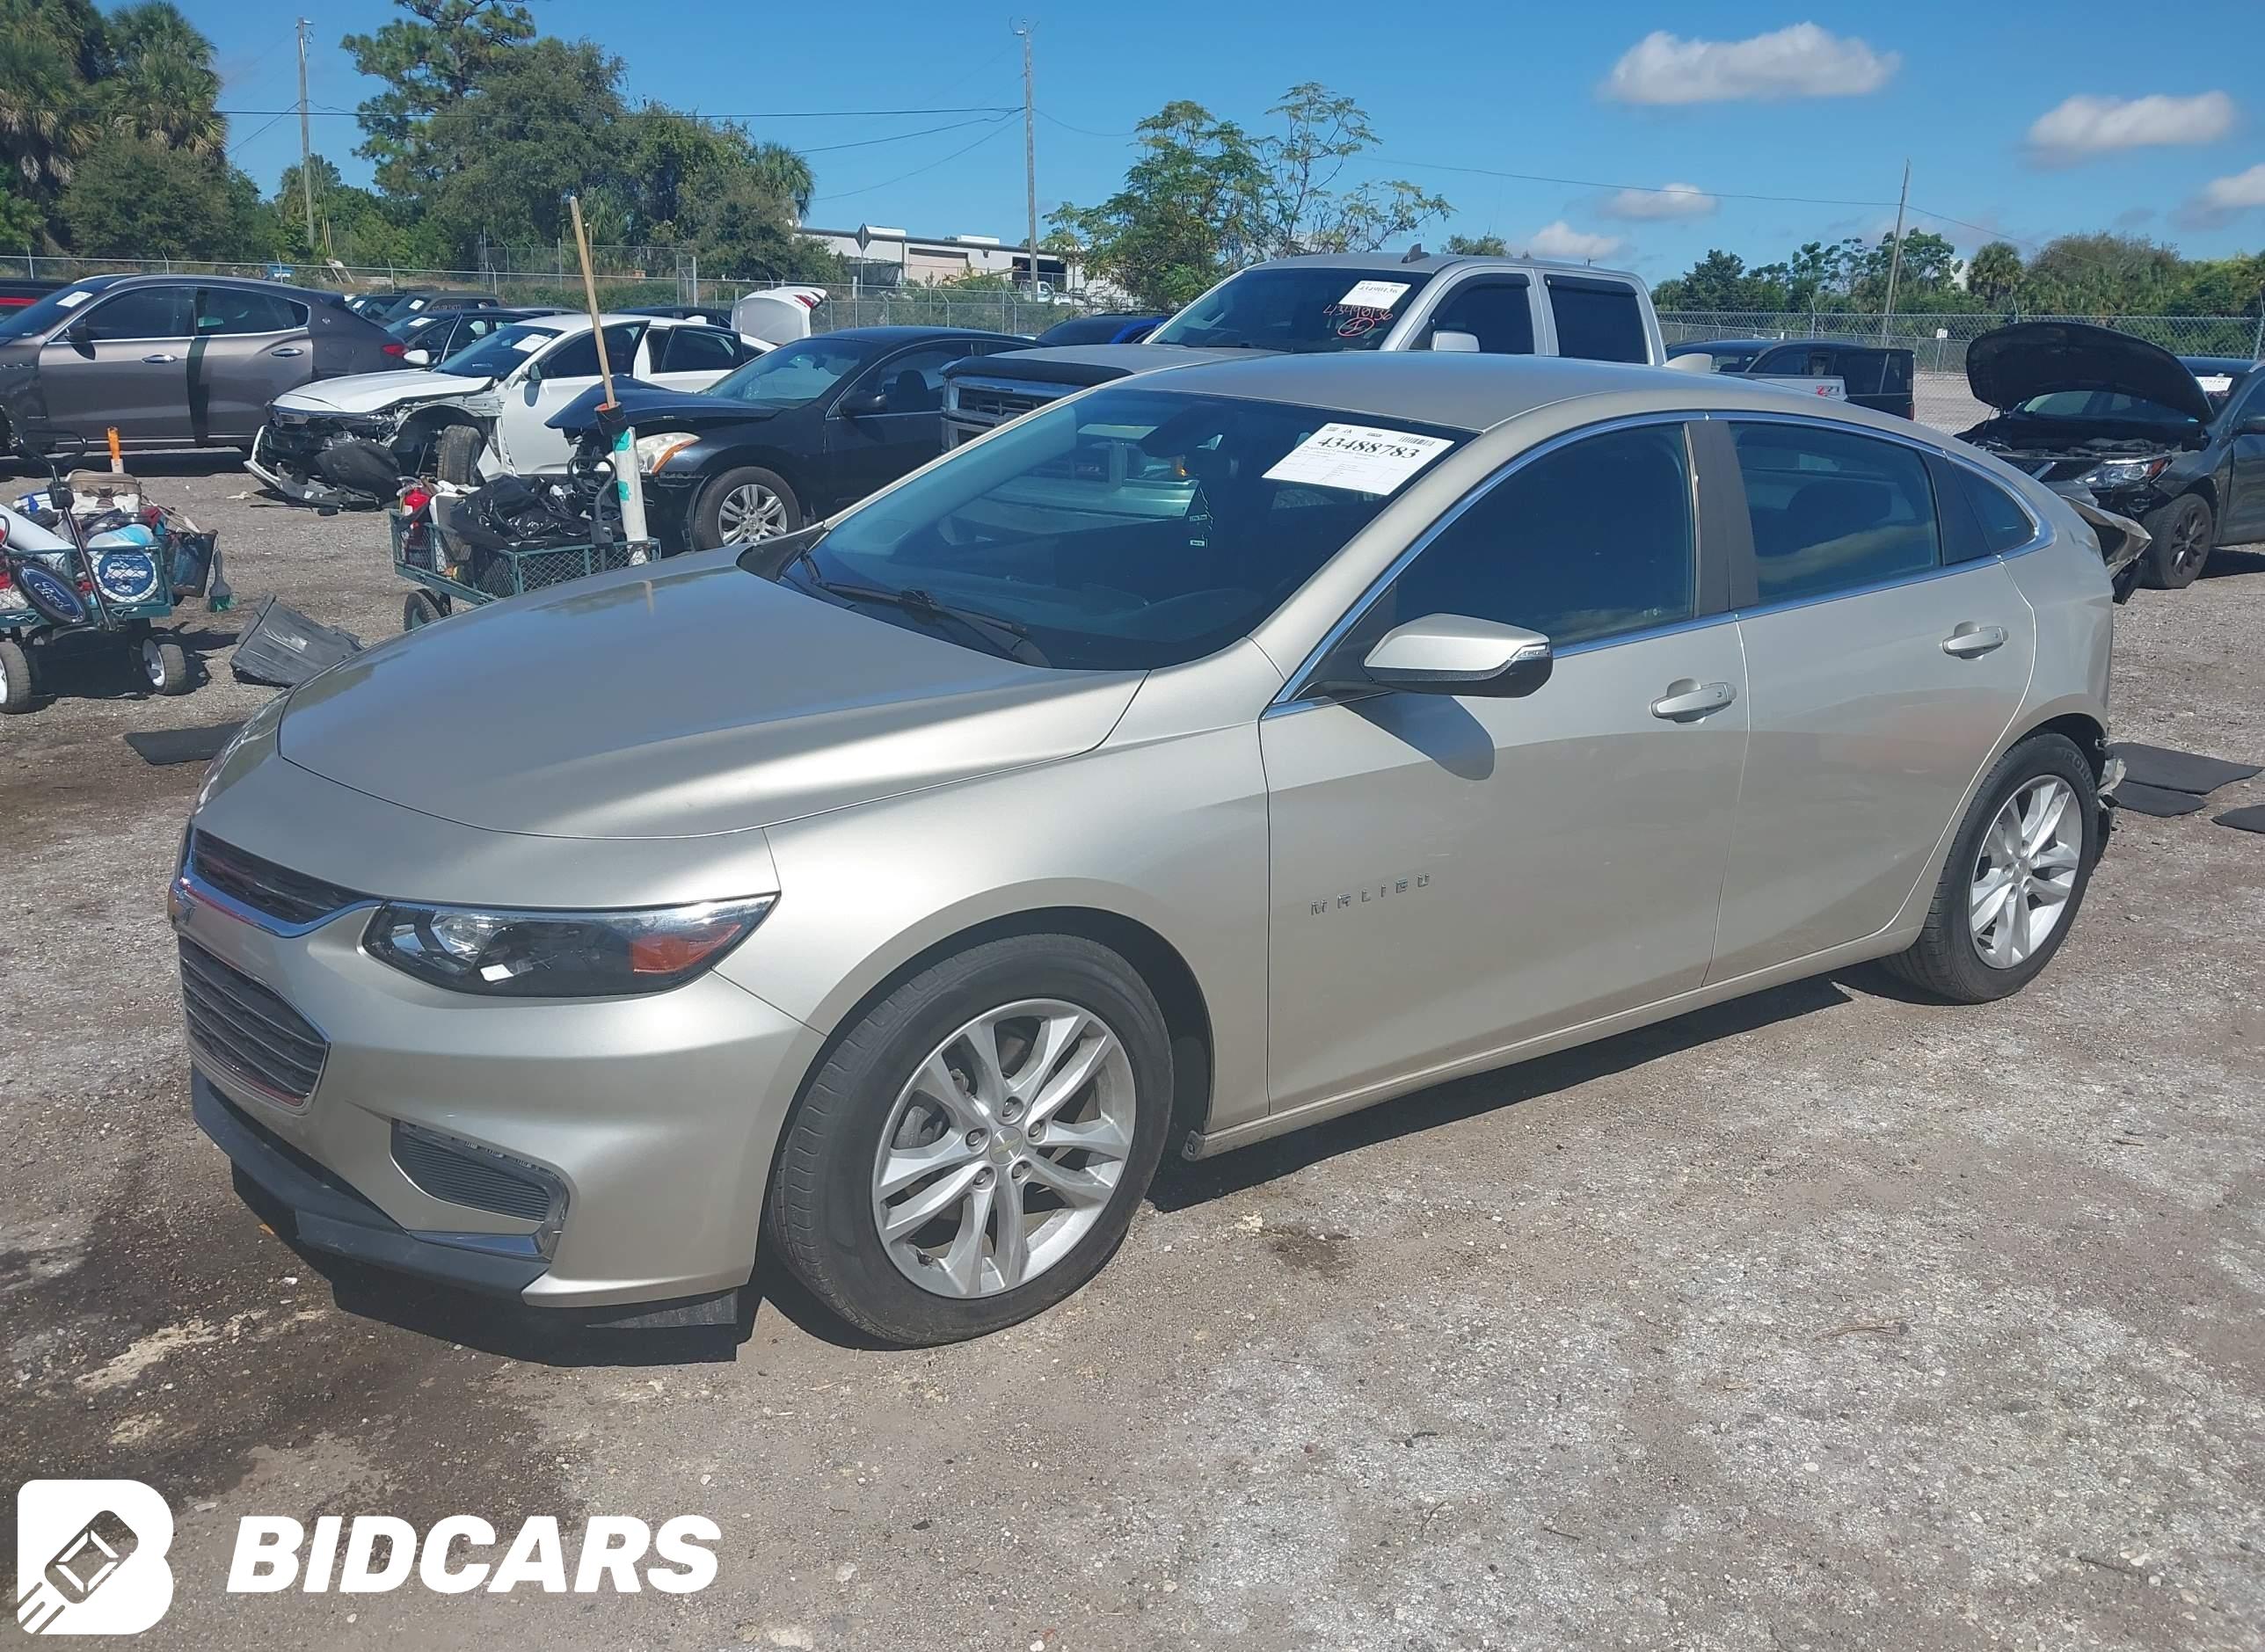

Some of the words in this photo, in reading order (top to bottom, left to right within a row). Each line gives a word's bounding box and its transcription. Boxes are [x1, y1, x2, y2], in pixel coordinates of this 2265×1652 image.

[1322, 304, 1394, 321] 43490136
[1318, 436, 1419, 458] 43488783
[33, 581, 70, 608] Ford
[1311, 874, 1431, 916] MALIBU
